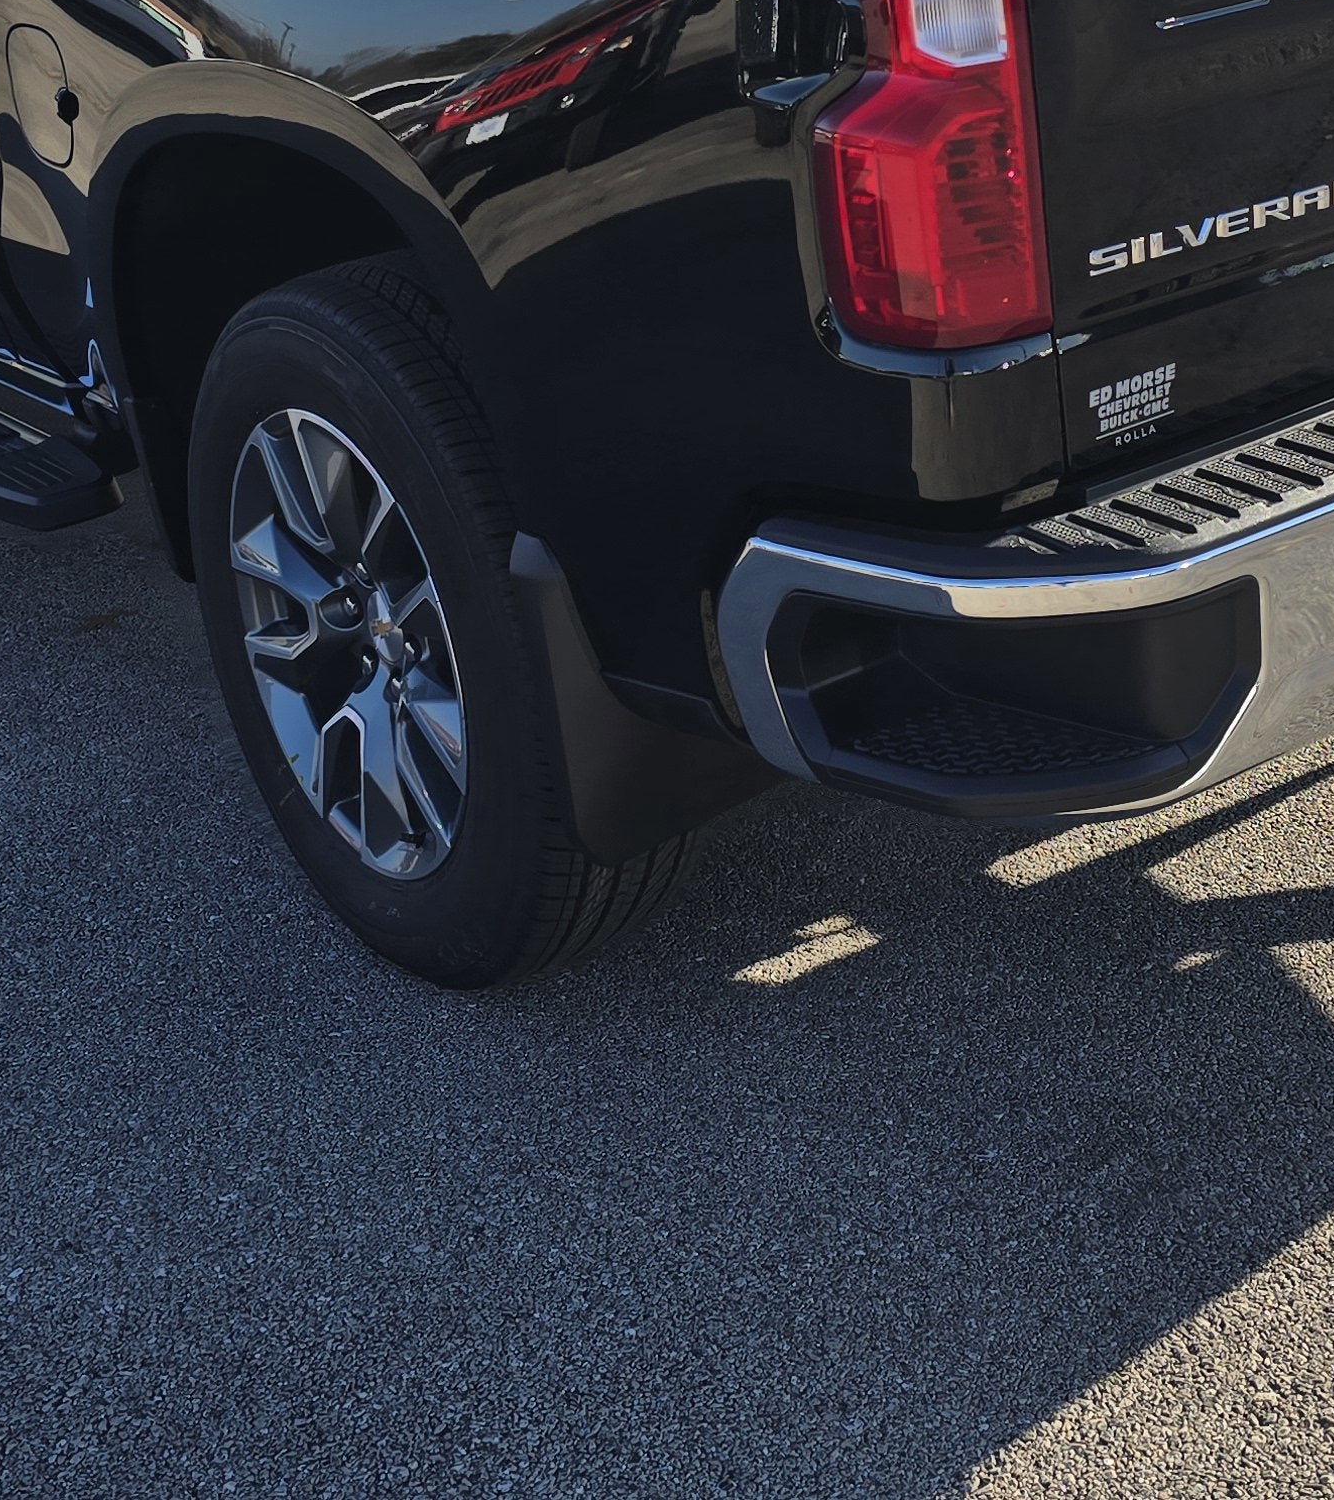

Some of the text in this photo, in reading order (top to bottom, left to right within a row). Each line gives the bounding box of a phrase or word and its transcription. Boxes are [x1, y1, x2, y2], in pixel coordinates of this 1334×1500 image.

[1089, 362, 1176, 409] ED MORSE
[1098, 382, 1171, 419] CHEVROLET
[1115, 424, 1156, 447] ROLLA
